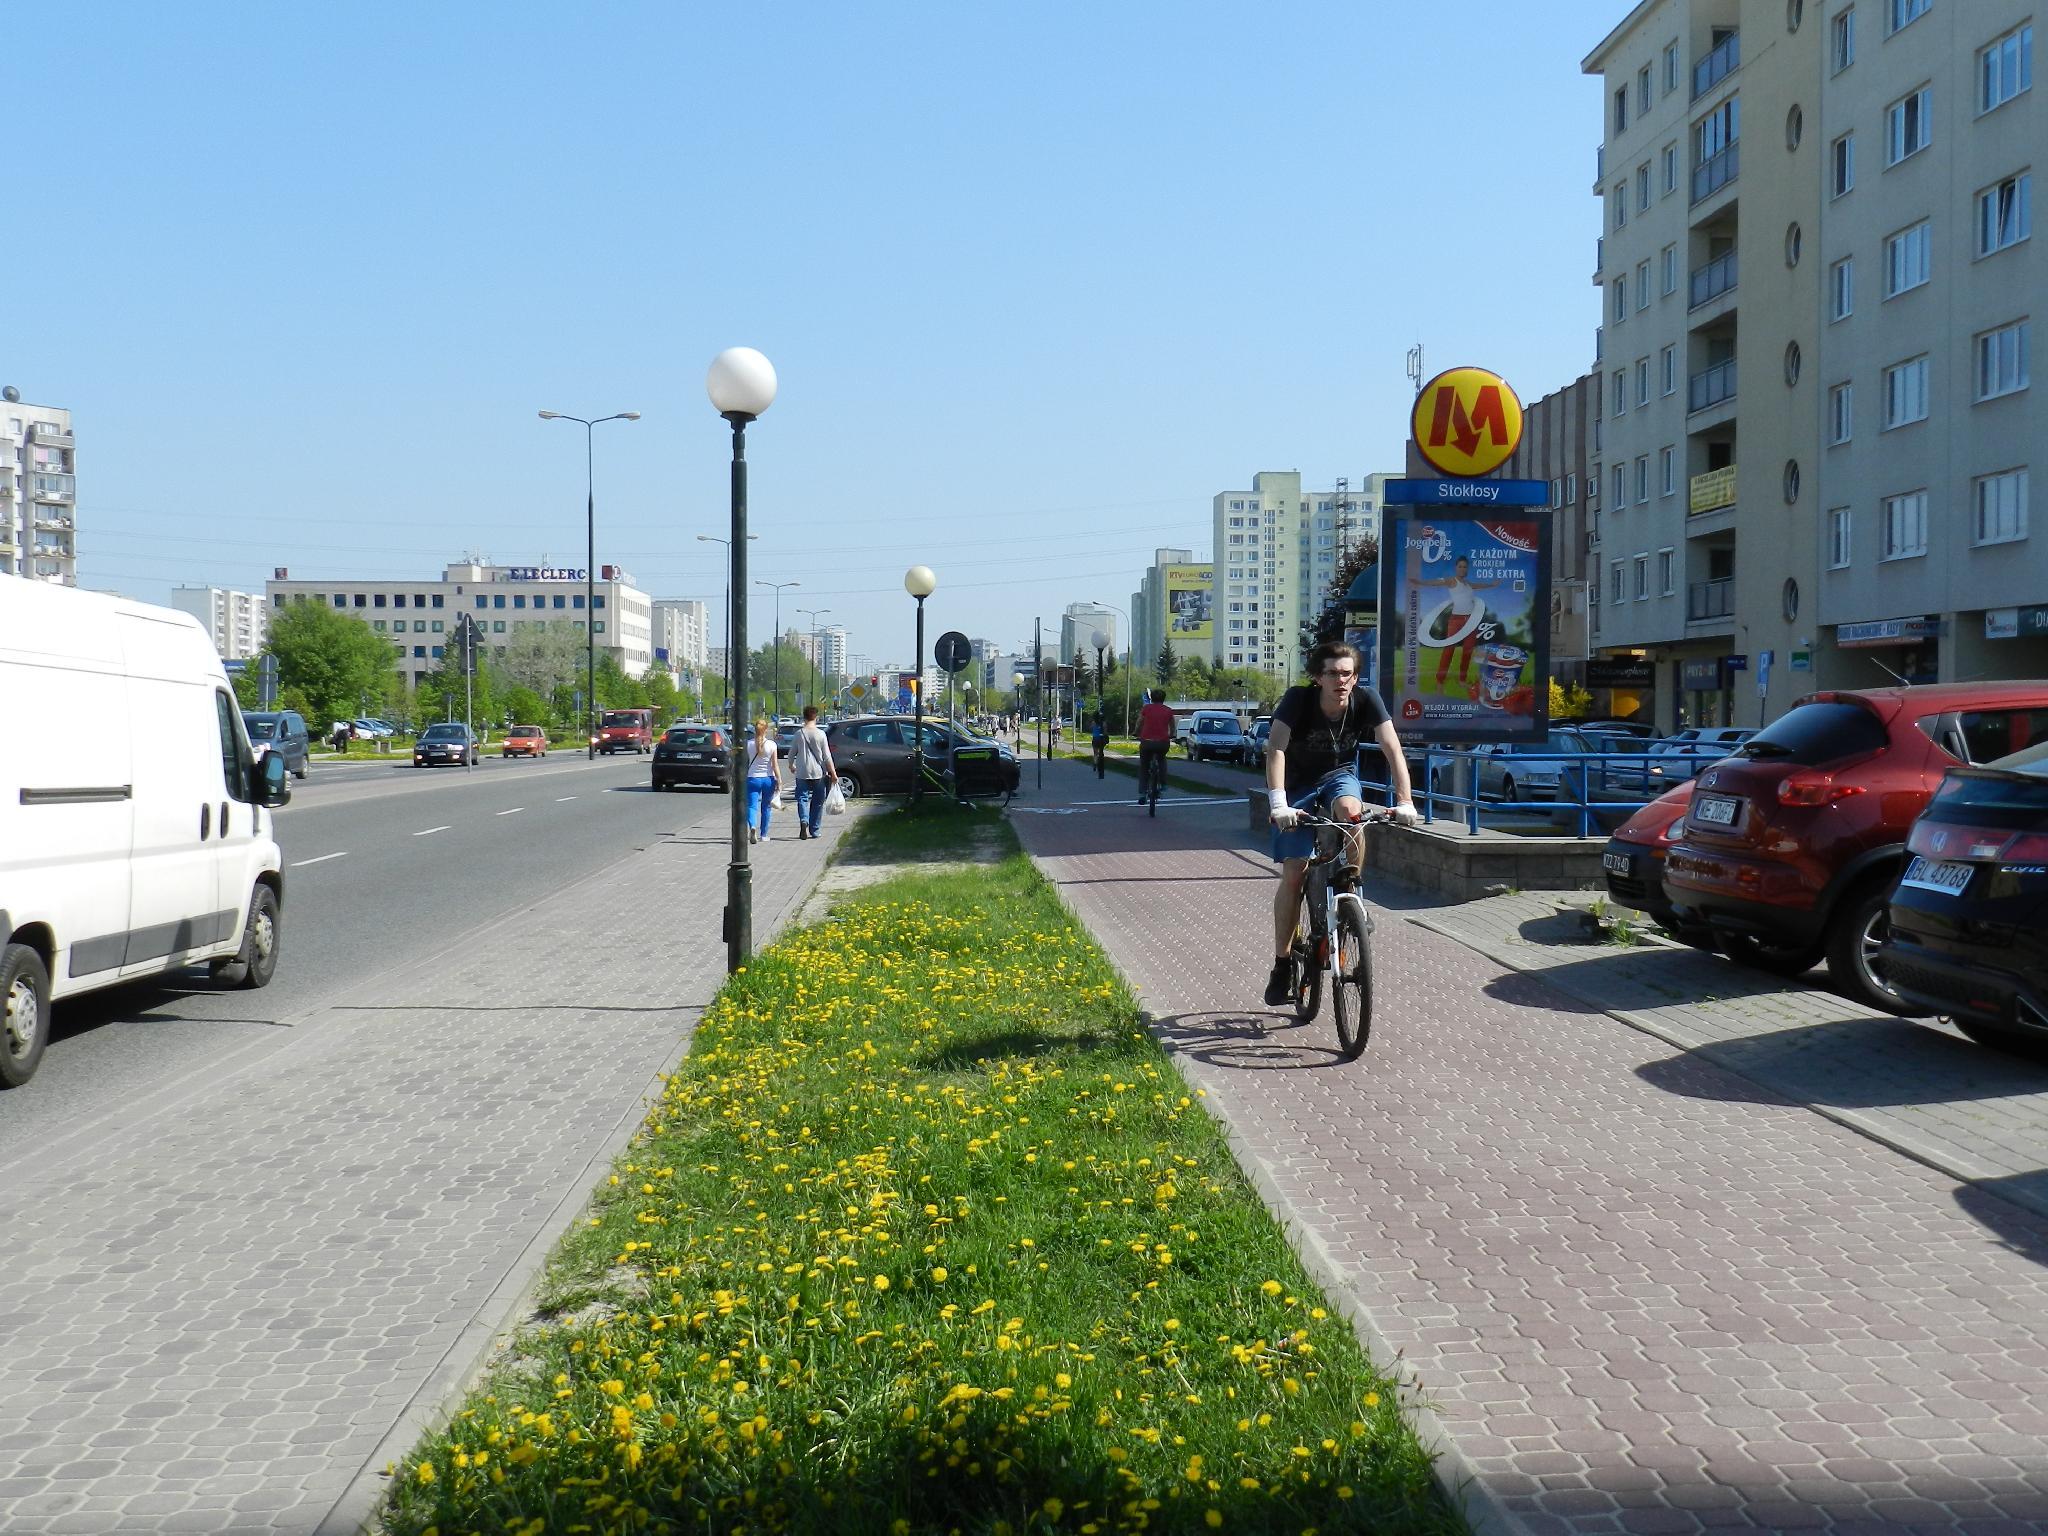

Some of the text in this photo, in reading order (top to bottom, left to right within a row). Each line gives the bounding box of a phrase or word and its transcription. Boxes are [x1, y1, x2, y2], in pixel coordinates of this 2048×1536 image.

[1438, 483, 1500, 500] Stokłosy
[1471, 547, 1518, 559] Z KAŻDYM
[1476, 568, 1526, 579] COŚ EXTRA
[1912, 860, 1927, 881] BL
